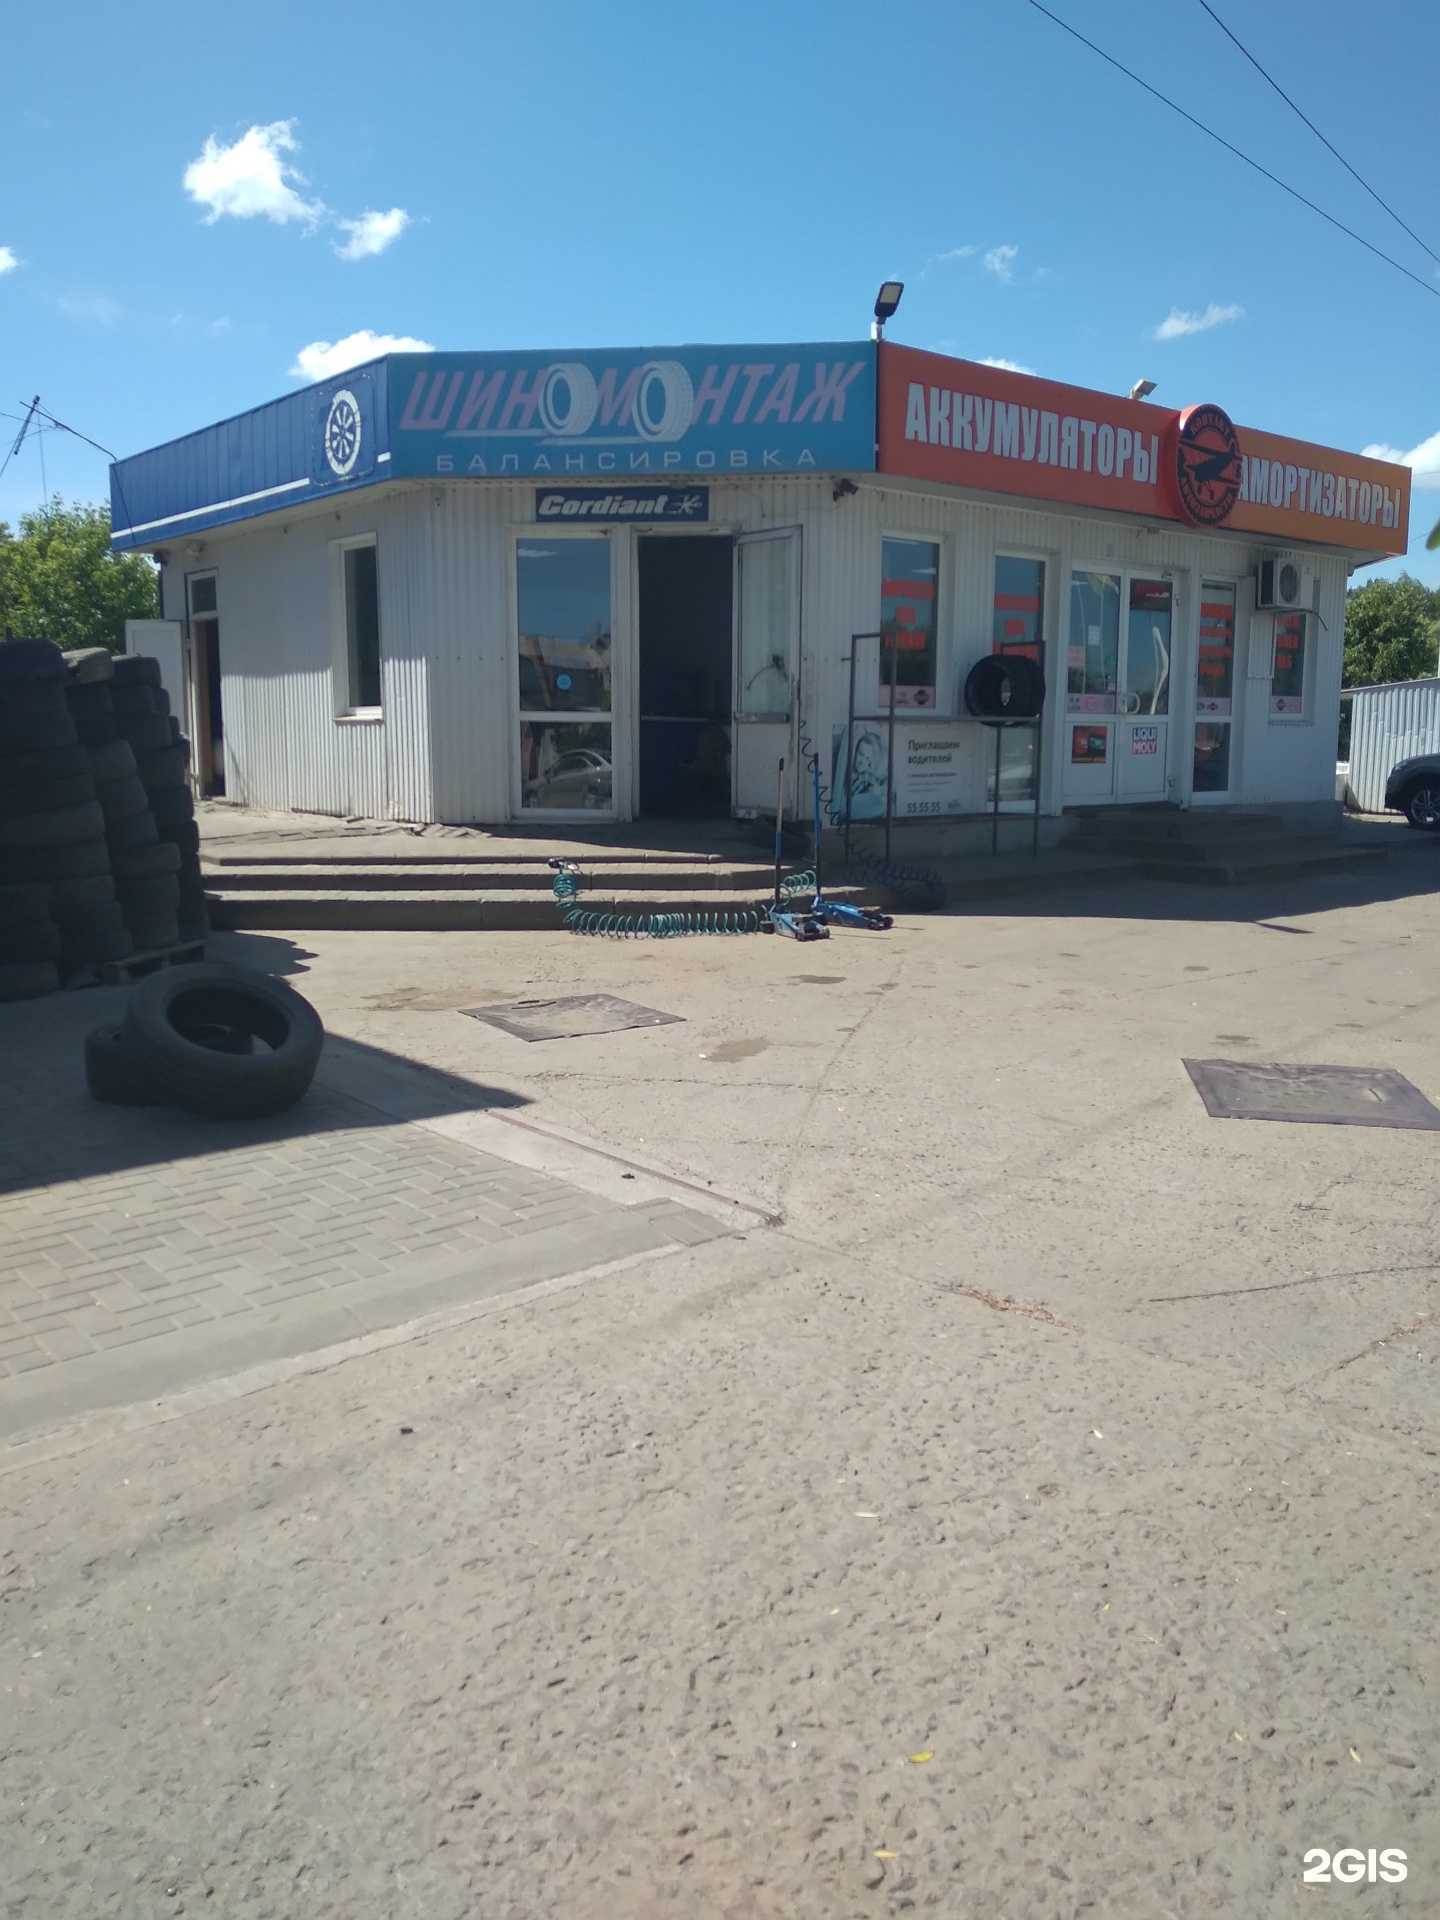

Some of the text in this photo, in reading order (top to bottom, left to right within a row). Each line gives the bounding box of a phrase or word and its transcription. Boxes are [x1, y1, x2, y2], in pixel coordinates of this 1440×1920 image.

[400, 361, 867, 442] ШИНОМОНТАЖ
[905, 382, 1159, 485] АККУМУЛЯТОРЫ
[435, 447, 817, 473] БАЛАНСИРОВКА
[1238, 455, 1401, 529] АМОРТИЗАТОРЫ
[538, 494, 669, 515] Cordiant
[1133, 727, 1156, 740] LIQUI
[907, 752, 953, 765] водителей
[1133, 741, 1156, 753] MOLY
